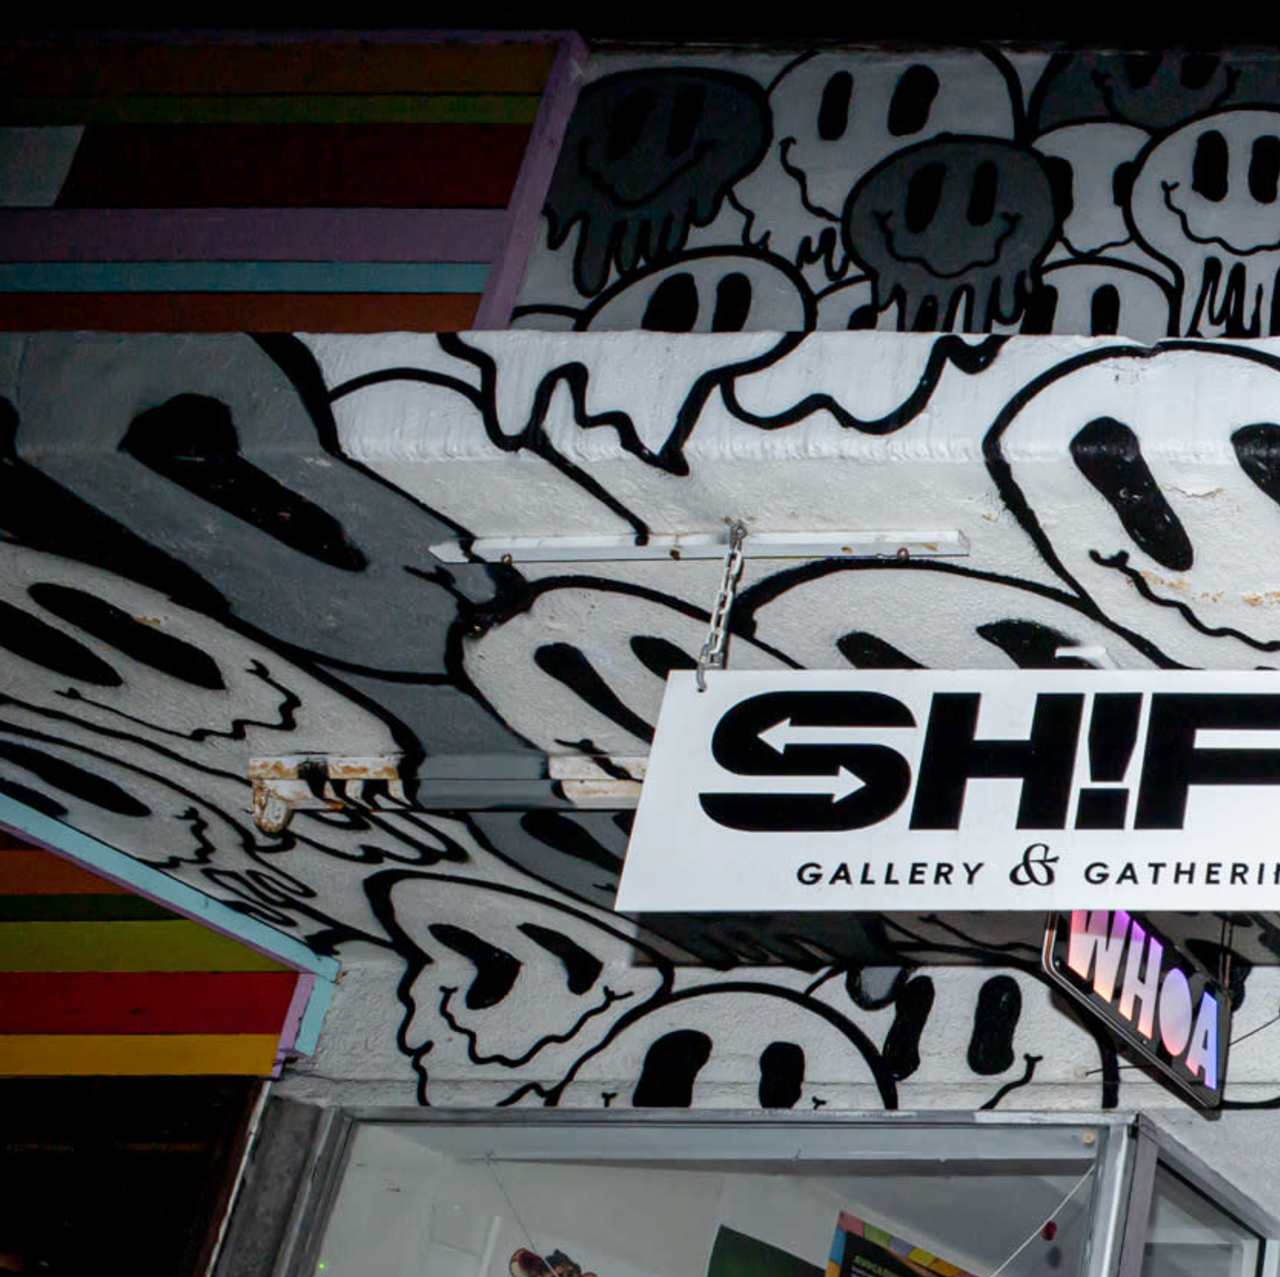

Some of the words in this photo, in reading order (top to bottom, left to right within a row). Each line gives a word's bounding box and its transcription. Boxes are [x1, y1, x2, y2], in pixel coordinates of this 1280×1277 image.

[796, 861, 985, 886] GALLERY
[1010, 843, 1059, 887] &
[1069, 910, 1217, 1091] WHOA
